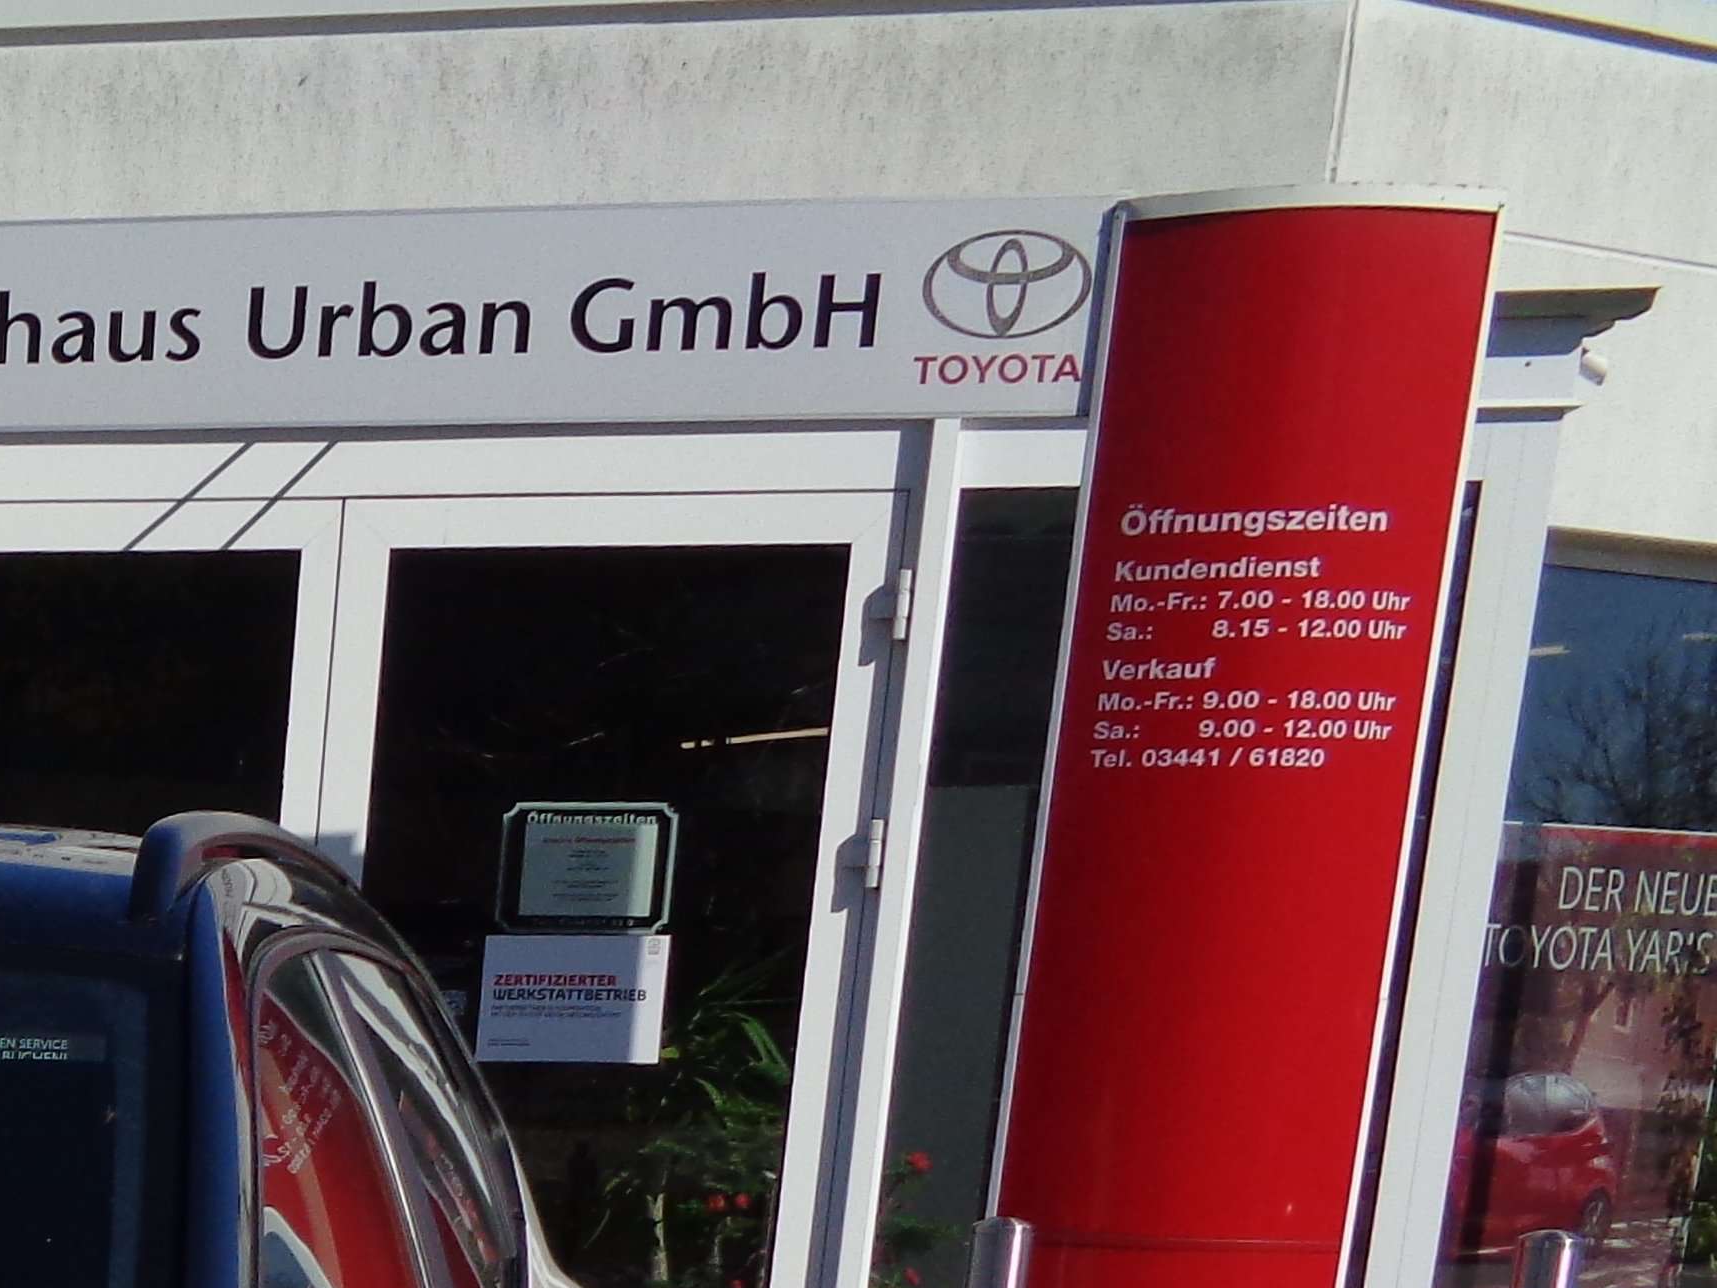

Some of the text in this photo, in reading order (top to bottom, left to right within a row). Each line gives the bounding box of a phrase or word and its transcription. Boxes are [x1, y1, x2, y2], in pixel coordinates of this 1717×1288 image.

[246, 281, 532, 361] Urban
[569, 272, 882, 354] GmbH
[913, 352, 1082, 386] TOYOTA
[1120, 503, 1389, 538] Öffnungszeiten
[1114, 555, 1322, 583] Kundendienst
[1109, 592, 1207, 613] Mo.-Fr.:
[1217, 589, 1274, 610] 7.00
[1300, 589, 1366, 610] 18.00
[1371, 591, 1411, 611] Uhr
[1106, 621, 1153, 642] Sa.:
[1211, 618, 1270, 639] 8.15
[1297, 619, 1362, 639] 12.00
[1367, 619, 1406, 640] Uhr
[1102, 657, 1216, 681] Verkauf
[1097, 691, 1193, 712] Mo.-Fr.:
[1202, 690, 1260, 710] 9.00
[1286, 690, 1352, 710] 18.00
[1357, 691, 1397, 712] Uhr
[1092, 720, 1141, 741] Sa.:
[1197, 718, 1256, 739] 9.00
[1283, 719, 1348, 739] 12.00
[1353, 720, 1393, 741] Uhr
[1090, 747, 1326, 769] Tel. 03441 / 61820
[1558, 866, 1717, 917] DER NEUE
[1484, 922, 1614, 971] TOYOTA
[493, 974, 617, 987] ZERTIFIZIERTER
[492, 988, 647, 1002] WERKSTATTBETRIEB
[19, 1038, 69, 1050] SERVICE
